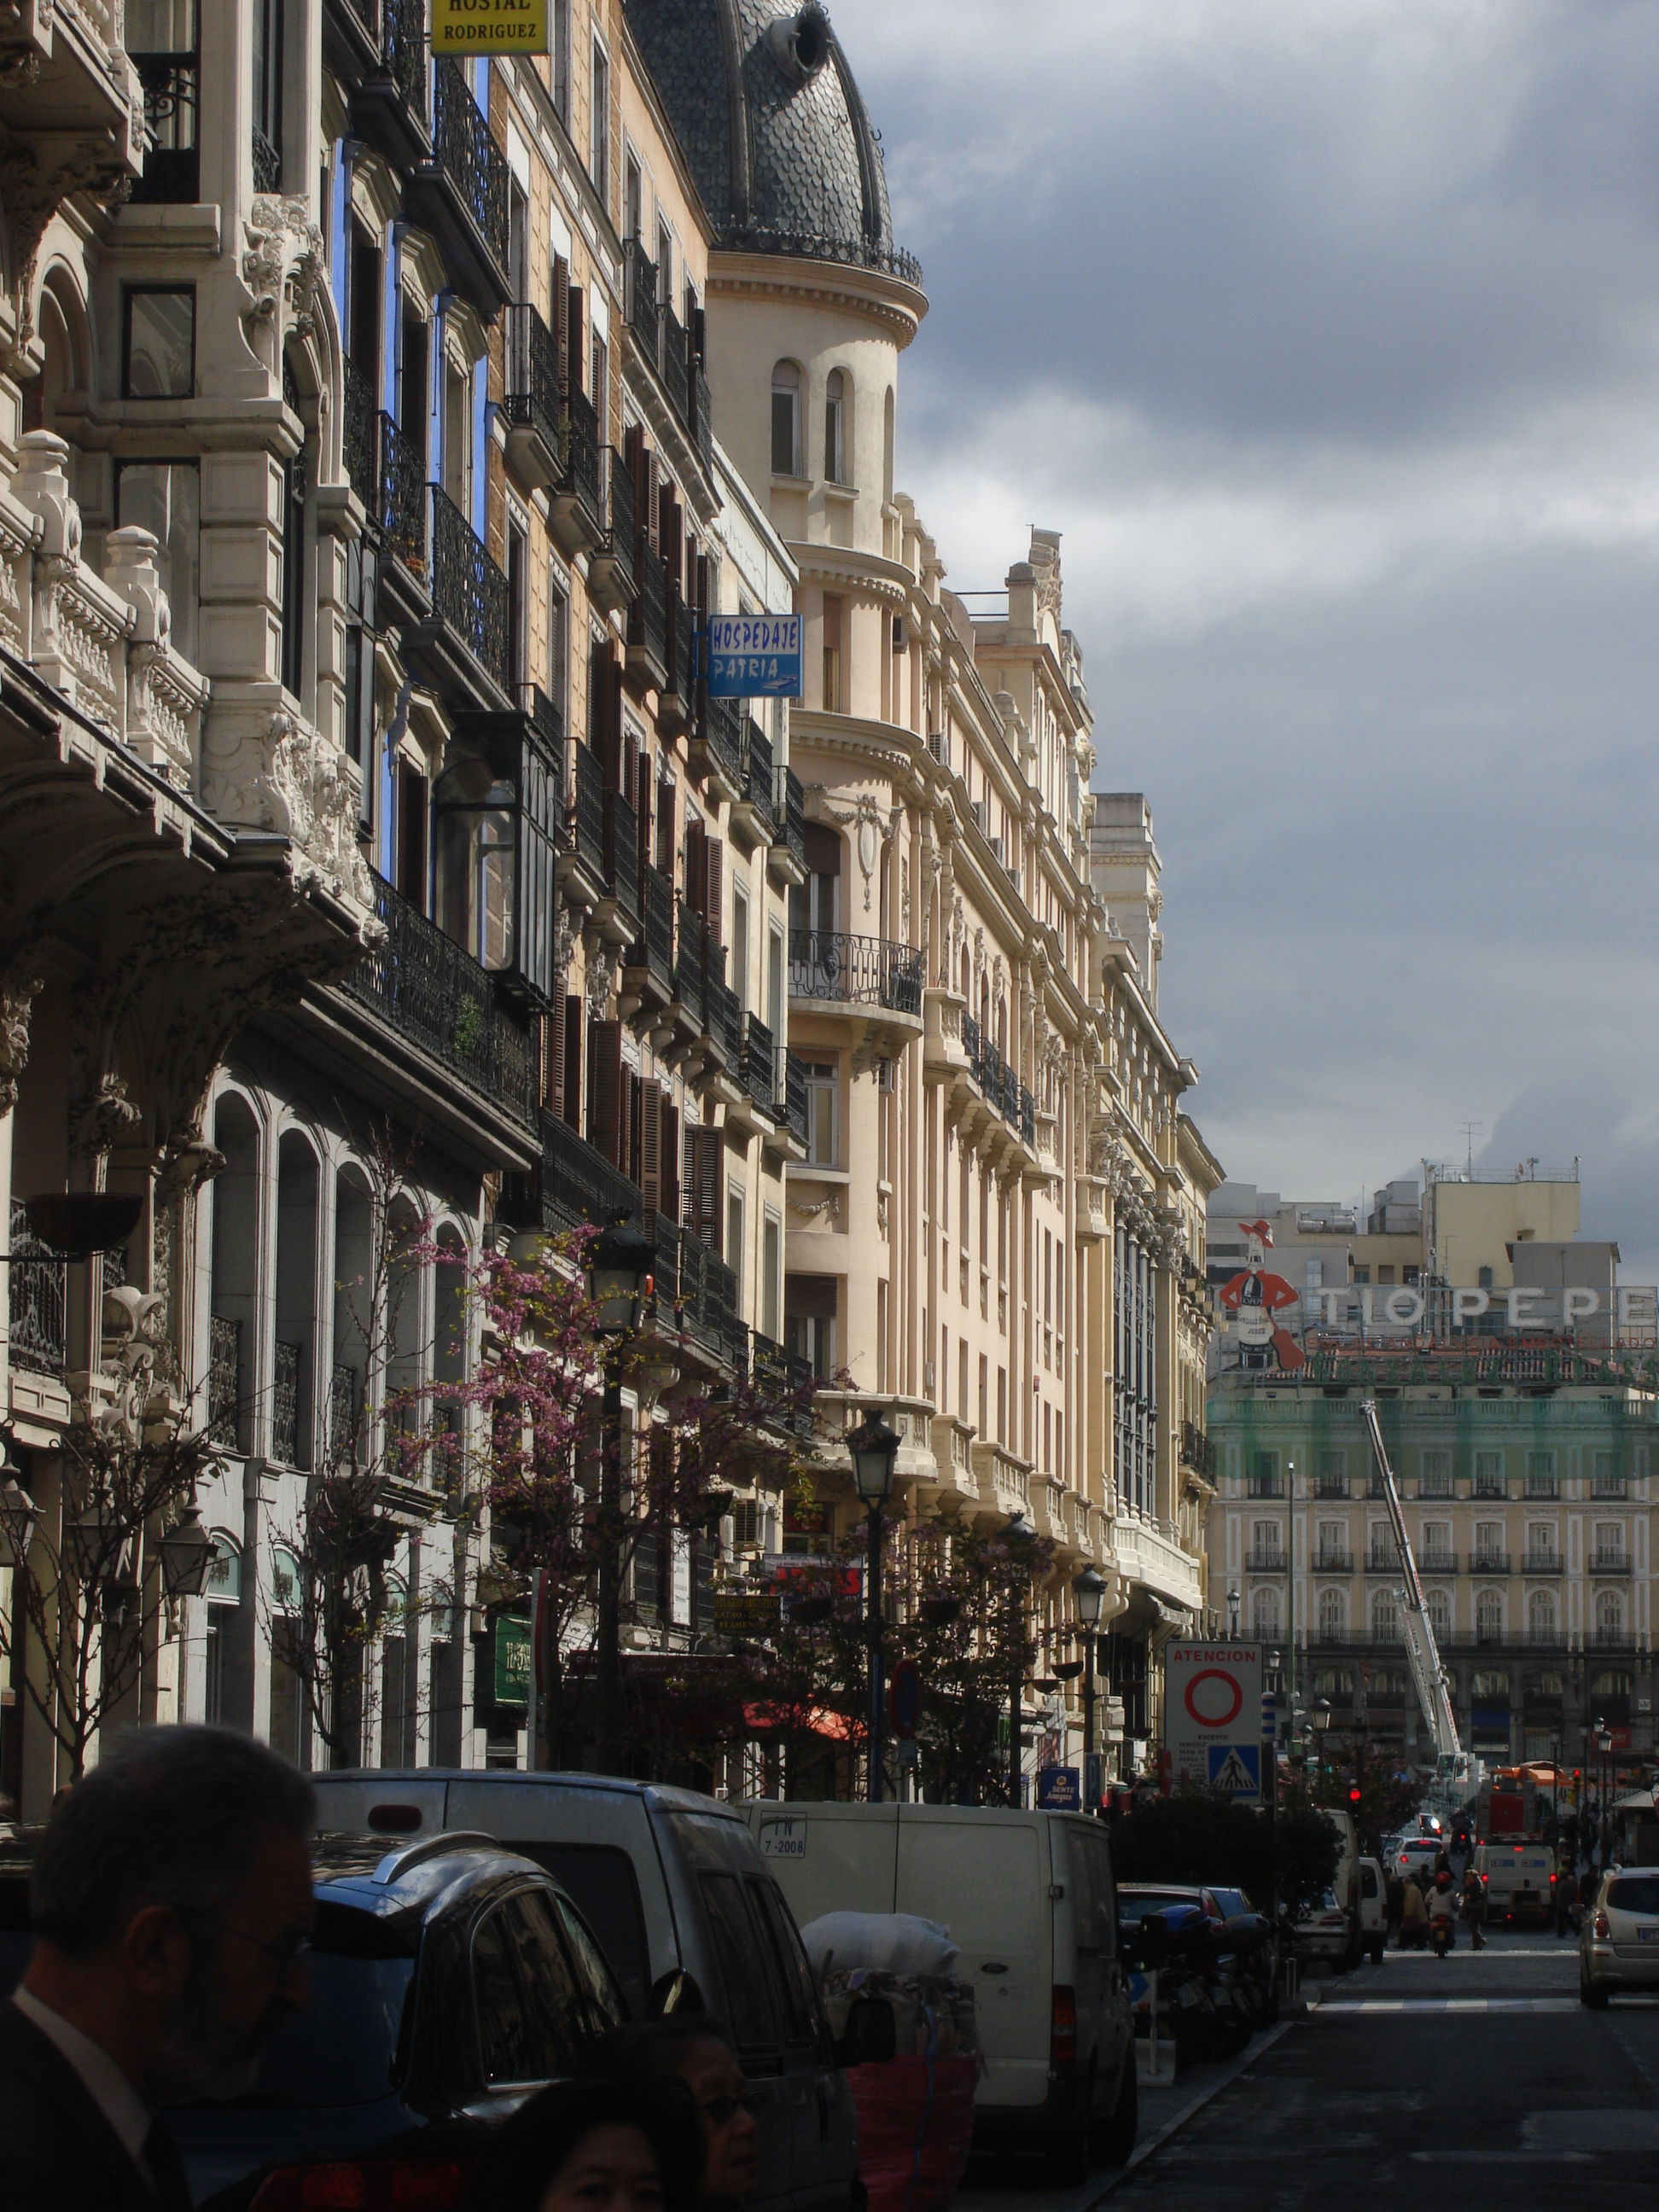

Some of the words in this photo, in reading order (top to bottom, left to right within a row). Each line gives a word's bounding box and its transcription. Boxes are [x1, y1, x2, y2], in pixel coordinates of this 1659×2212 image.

[449, 0, 531, 11] HOSTAL
[445, 24, 536, 39] RODRIGUEZ
[714, 622, 796, 651] HOSPEDAJE
[713, 658, 777, 679] PATRIA
[1316, 1287, 1425, 1326] TIO
[1452, 1287, 1656, 1327] PEPE
[1173, 1649, 1255, 1663] ATENCION
